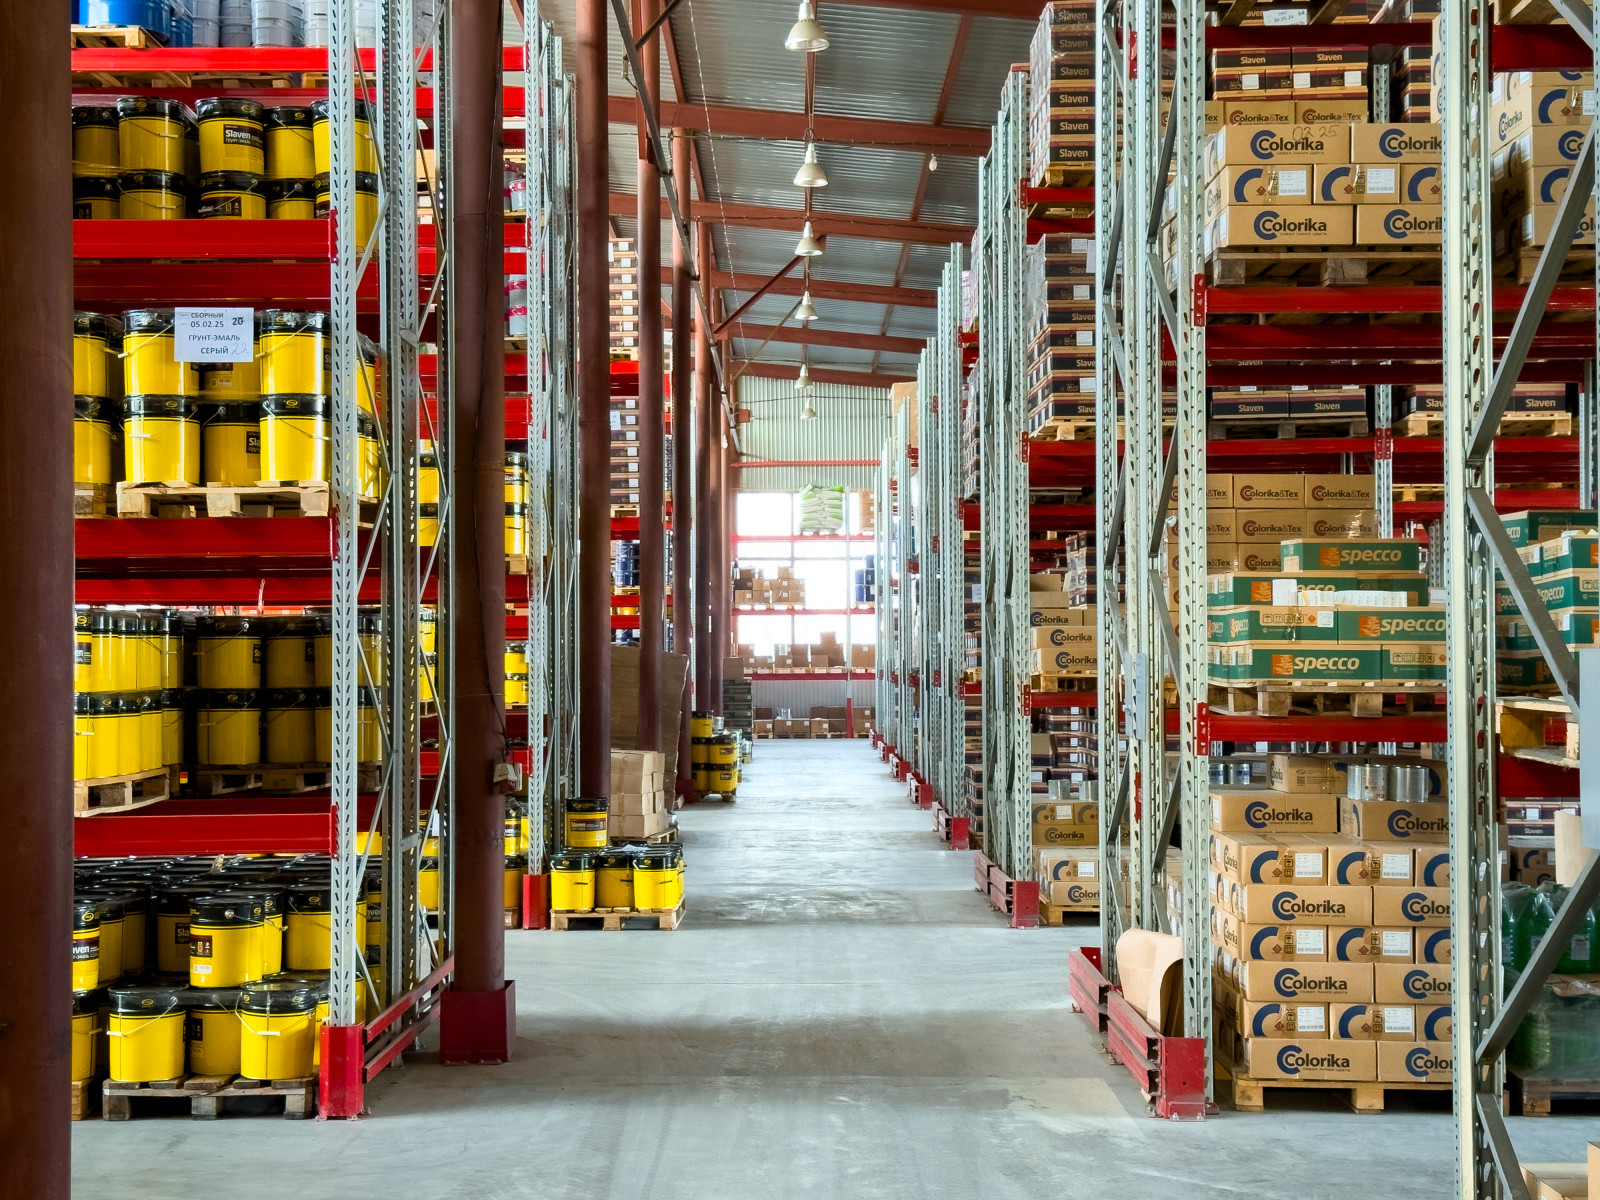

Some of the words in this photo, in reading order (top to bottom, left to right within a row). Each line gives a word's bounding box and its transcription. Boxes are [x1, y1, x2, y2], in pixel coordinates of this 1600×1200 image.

[1058, 11, 1088, 20] Slaven
[1059, 39, 1088, 48] Slaven
[1240, 56, 1266, 65] Slaven
[1317, 53, 1343, 62] Slaven
[1060, 67, 1089, 76] Slaven
[1059, 94, 1088, 103] Slaven
[1059, 122, 1088, 131] Slaven
[225, 129, 250, 139] Slaven
[1251, 134, 1324, 154] Colorika
[1379, 134, 1442, 154] Colorik
[1059, 149, 1088, 158] Slaven
[1254, 215, 1327, 235] Colorika
[1384, 213, 1442, 234] Colori
[1069, 266, 1086, 274] Slav
[200, 345, 229, 354] СЕРЫЙ
[1238, 404, 1264, 412] Slaven
[1314, 402, 1340, 410] Slaven
[1426, 398, 1443, 407] Slav
[1525, 398, 1556, 407] Slaven
[1162, 405, 1177, 413] ven
[248, 437, 260, 446] Sla
[1240, 487, 1299, 499] Colorika&Tex
[1312, 487, 1370, 499] Colorika&Tex
[1506, 526, 1521, 539] ecco
[1340, 549, 1402, 565] specco
[1501, 594, 1516, 607] spec
[1541, 586, 1565, 605] specco
[1030, 613, 1069, 625] Colorika
[1380, 618, 1446, 634] specco
[1050, 631, 1092, 643] Colorika
[1293, 657, 1360, 673] specco
[1245, 805, 1313, 824] Colorika
[1388, 813, 1448, 834] Colorik
[1045, 828, 1085, 841] Colorika
[1524, 827, 1544, 835] Slaven
[1068, 887, 1100, 901] Colori
[1273, 896, 1345, 917] Colorika
[1402, 898, 1450, 918] Color
[177, 928, 190, 937] Sla
[1274, 973, 1348, 993] Colorika
[1403, 974, 1451, 994] Color
[1277, 1050, 1350, 1070] Colorika
[1406, 1052, 1453, 1072] Color
